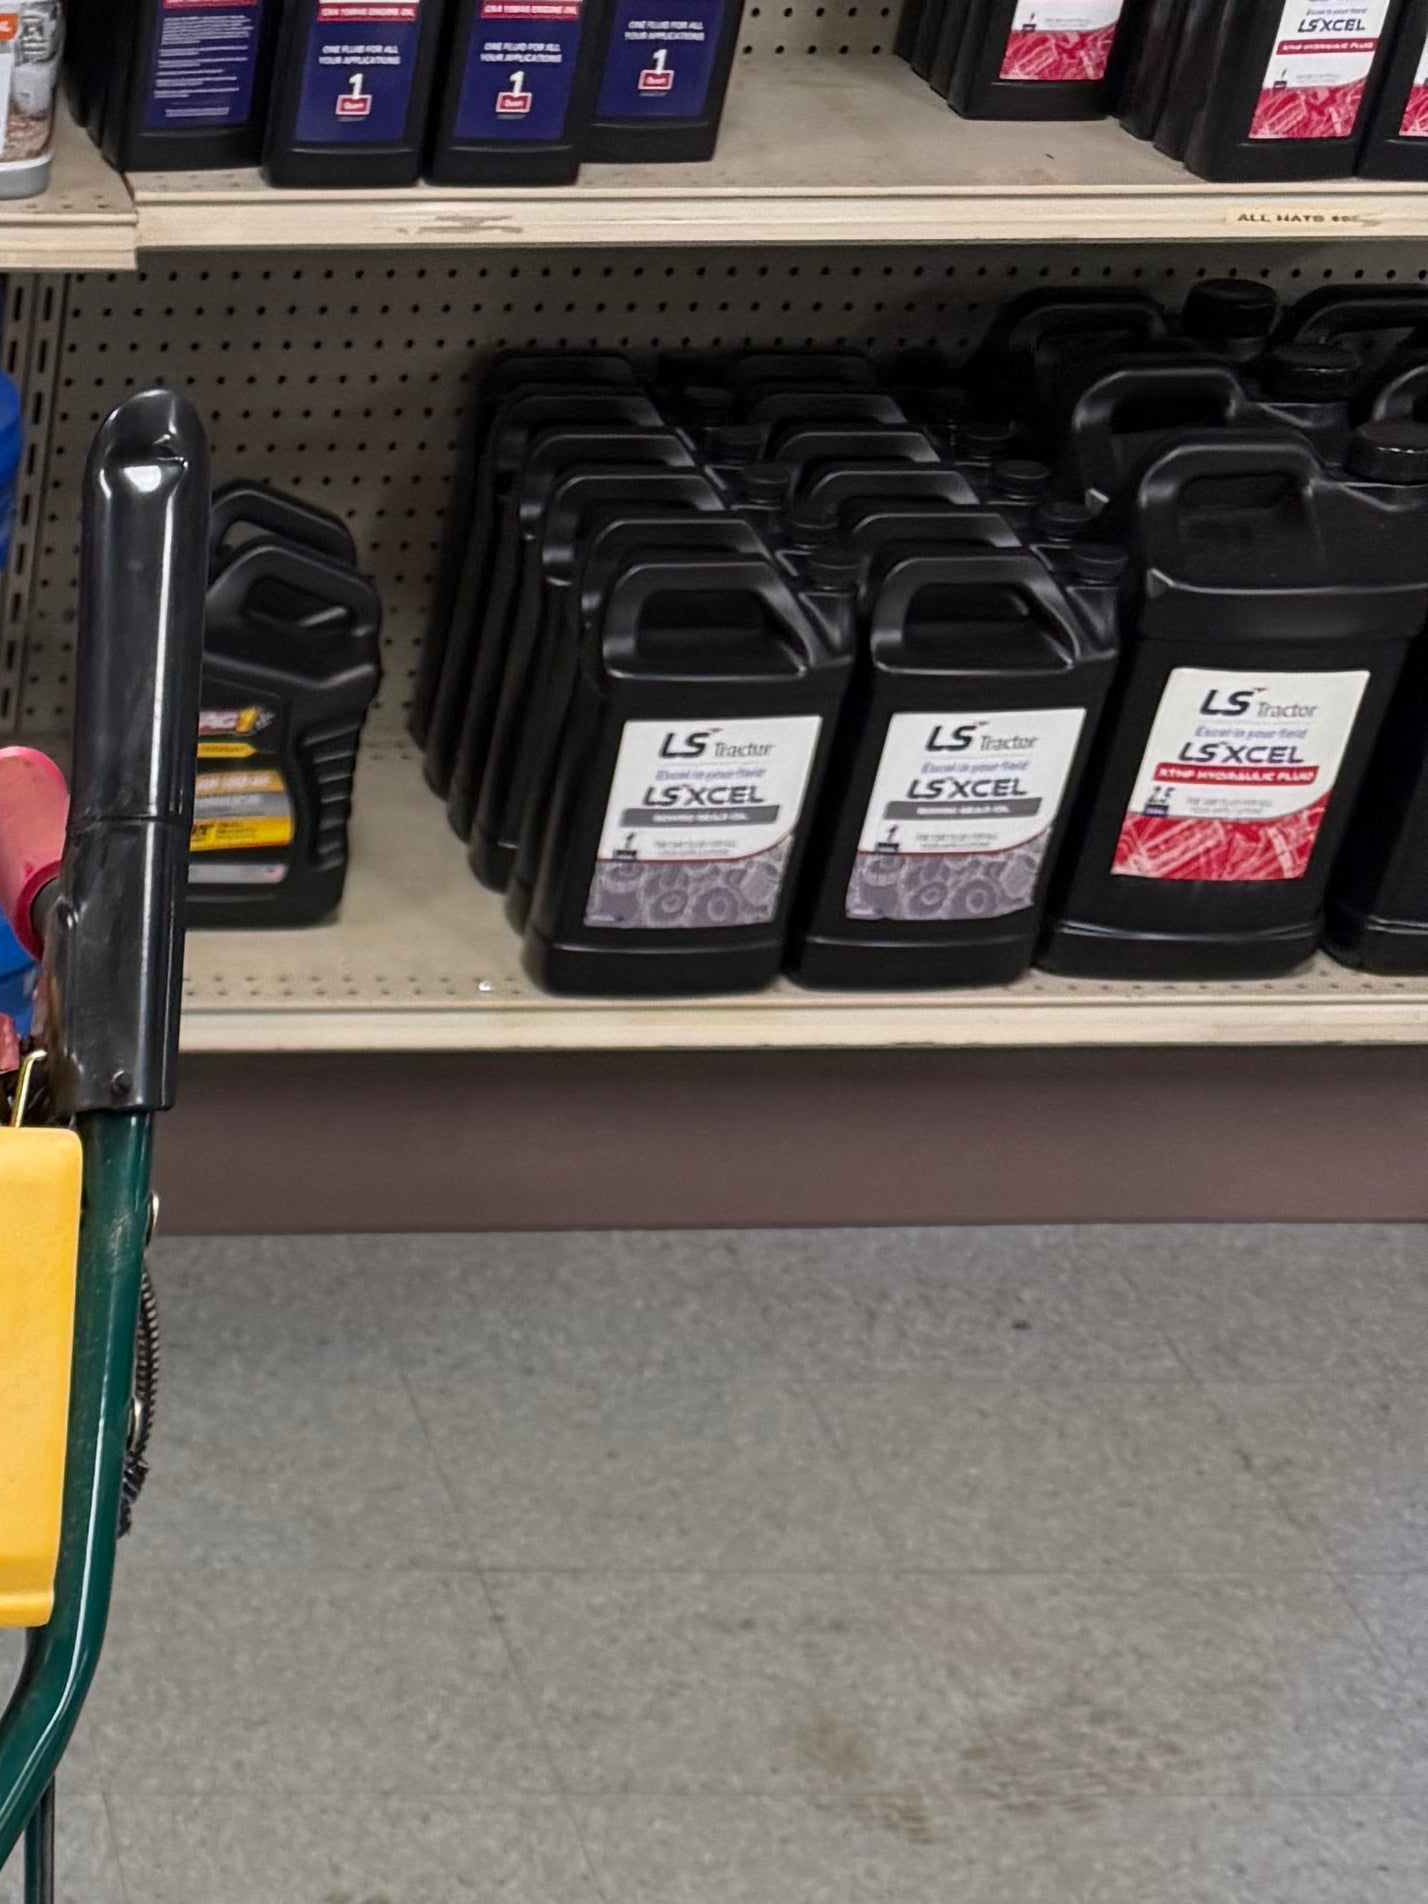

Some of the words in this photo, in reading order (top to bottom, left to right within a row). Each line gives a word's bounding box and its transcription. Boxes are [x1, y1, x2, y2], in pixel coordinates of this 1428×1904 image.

[1237, 214, 1268, 223] ALL
[1200, 689, 1254, 716] LS
[1257, 701, 1319, 718] Tractor
[659, 732, 710, 759] LS
[925, 725, 975, 751] LS
[980, 735, 1038, 750] Tractor
